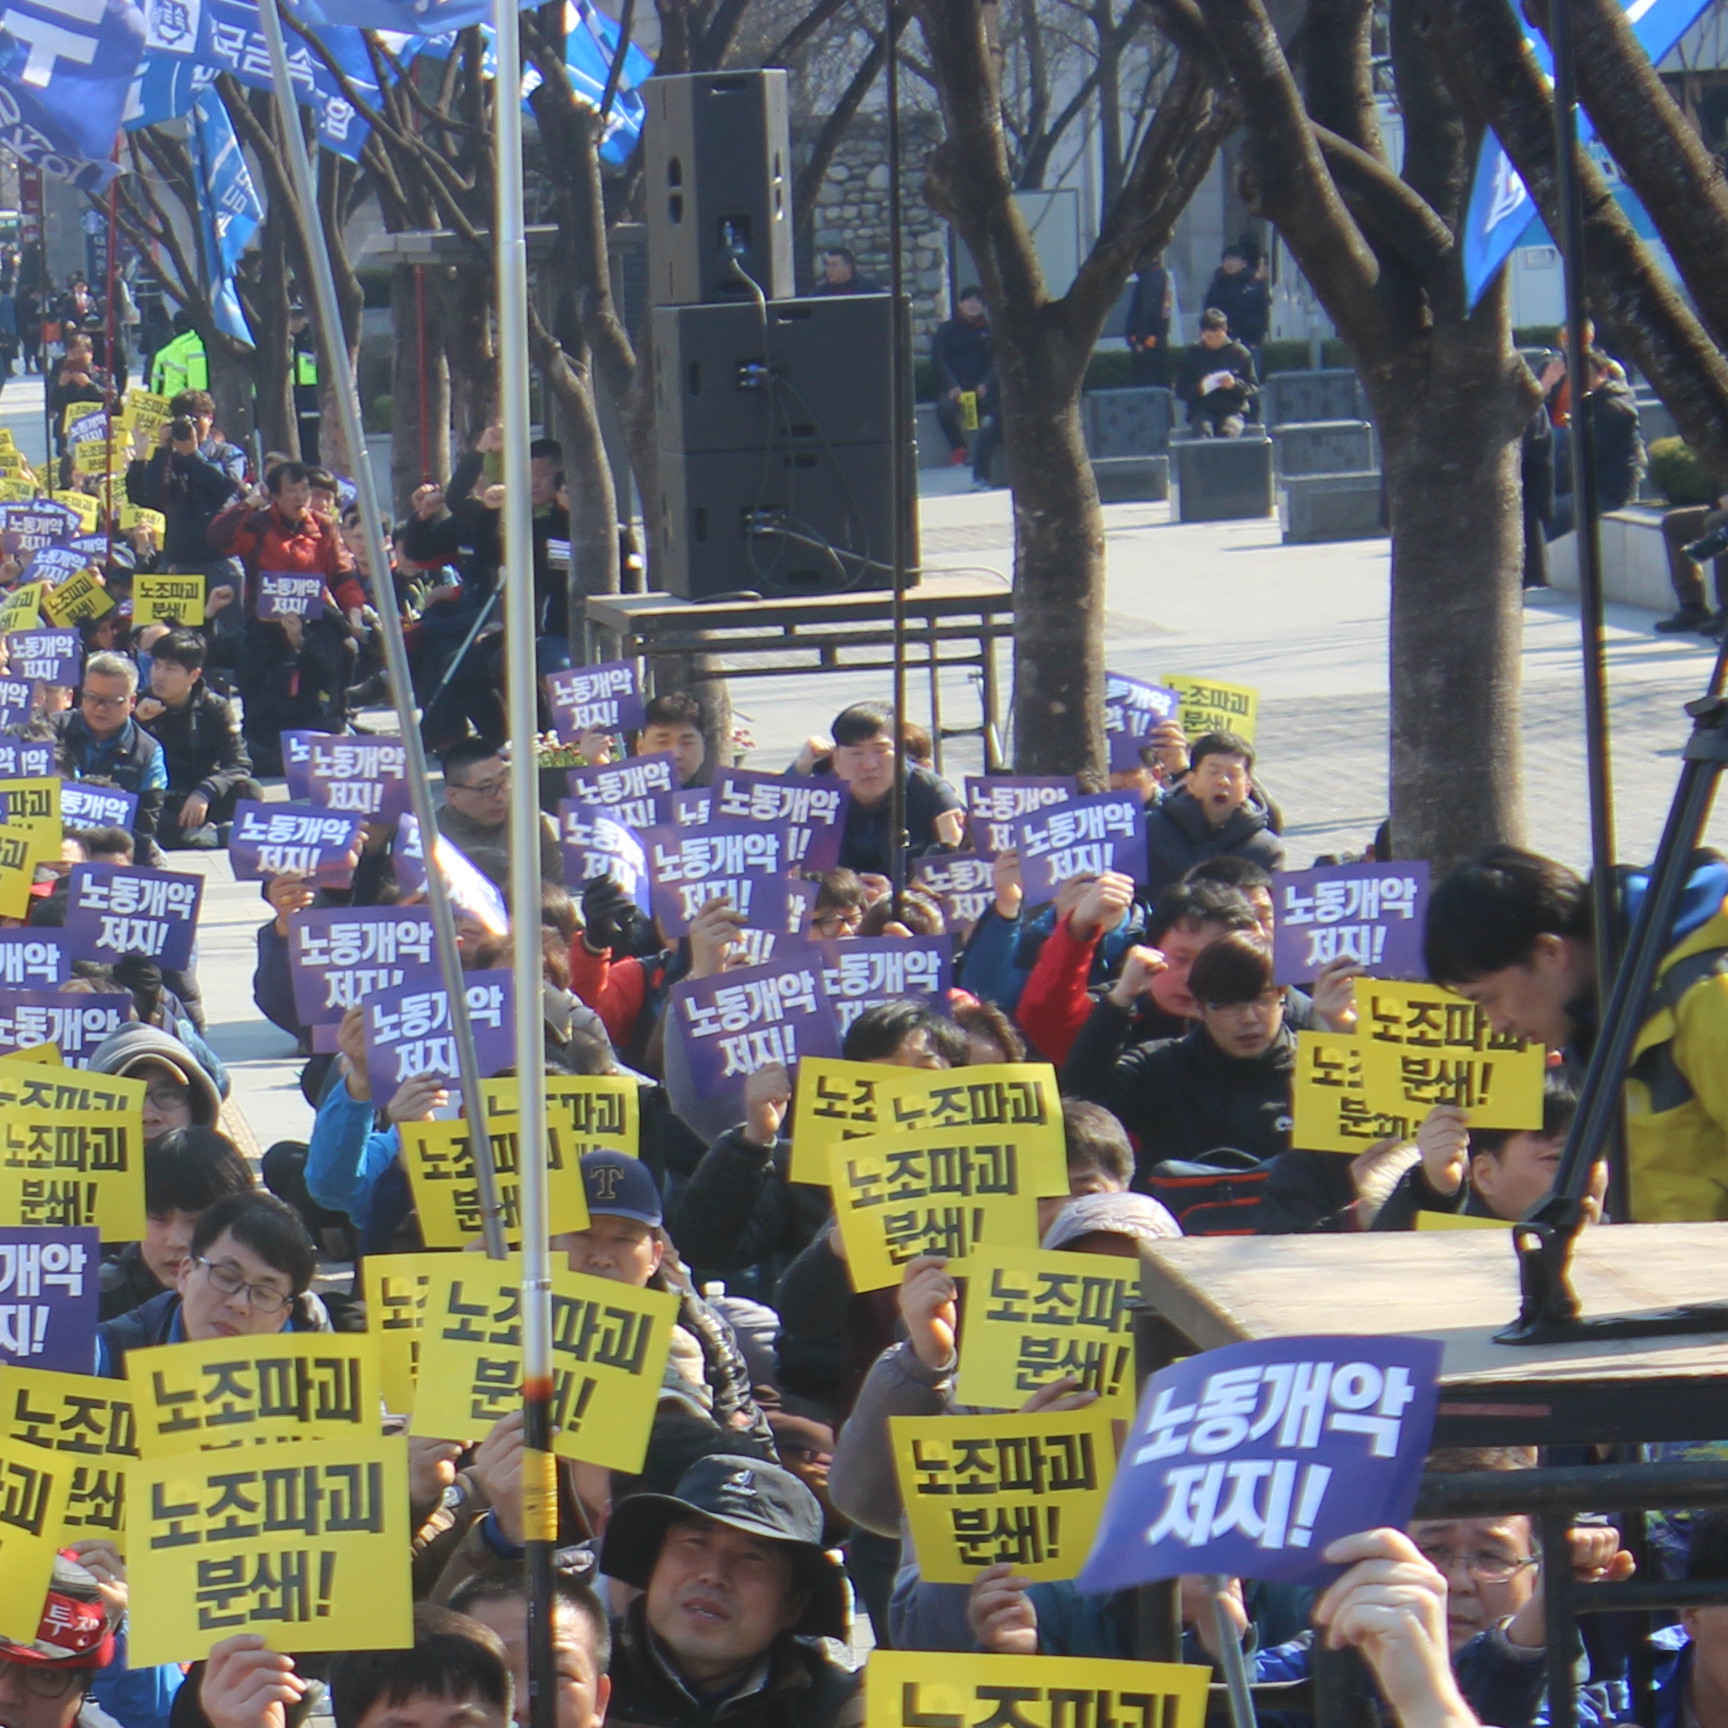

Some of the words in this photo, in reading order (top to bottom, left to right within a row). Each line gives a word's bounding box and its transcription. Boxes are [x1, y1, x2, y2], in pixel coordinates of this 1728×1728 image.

[140, 579, 199, 603] 노조파괴
[153, 602, 190, 621] 분쇄!
[261, 577, 321, 600] 노동개악
[270, 596, 308, 615] 저지!
[13, 634, 74, 658] 노동개악
[22, 656, 60, 681] 저지!
[571, 700, 620, 730] 저지!
[326, 781, 383, 814] 저지!
[238, 809, 352, 848] 노동개악
[255, 846, 321, 878] 저지!
[653, 832, 782, 884] 노동개악
[1284, 877, 1419, 934] 노동개악
[300, 918, 435, 968] 노동개악
[684, 969, 817, 1039] 노동개악
[6, 1122, 129, 1173] 노조파괴
[845, 1143, 1019, 1215] 노조파괴
[152, 1355, 363, 1436] 노조파괴
[1133, 1358, 1416, 1466] 노동개악
[911, 1432, 1096, 1497] 노조파괴
[149, 1460, 386, 1551] 노조파괴
[1148, 1457, 1336, 1550] 저지!
[194, 1548, 336, 1632] 분쇄!
